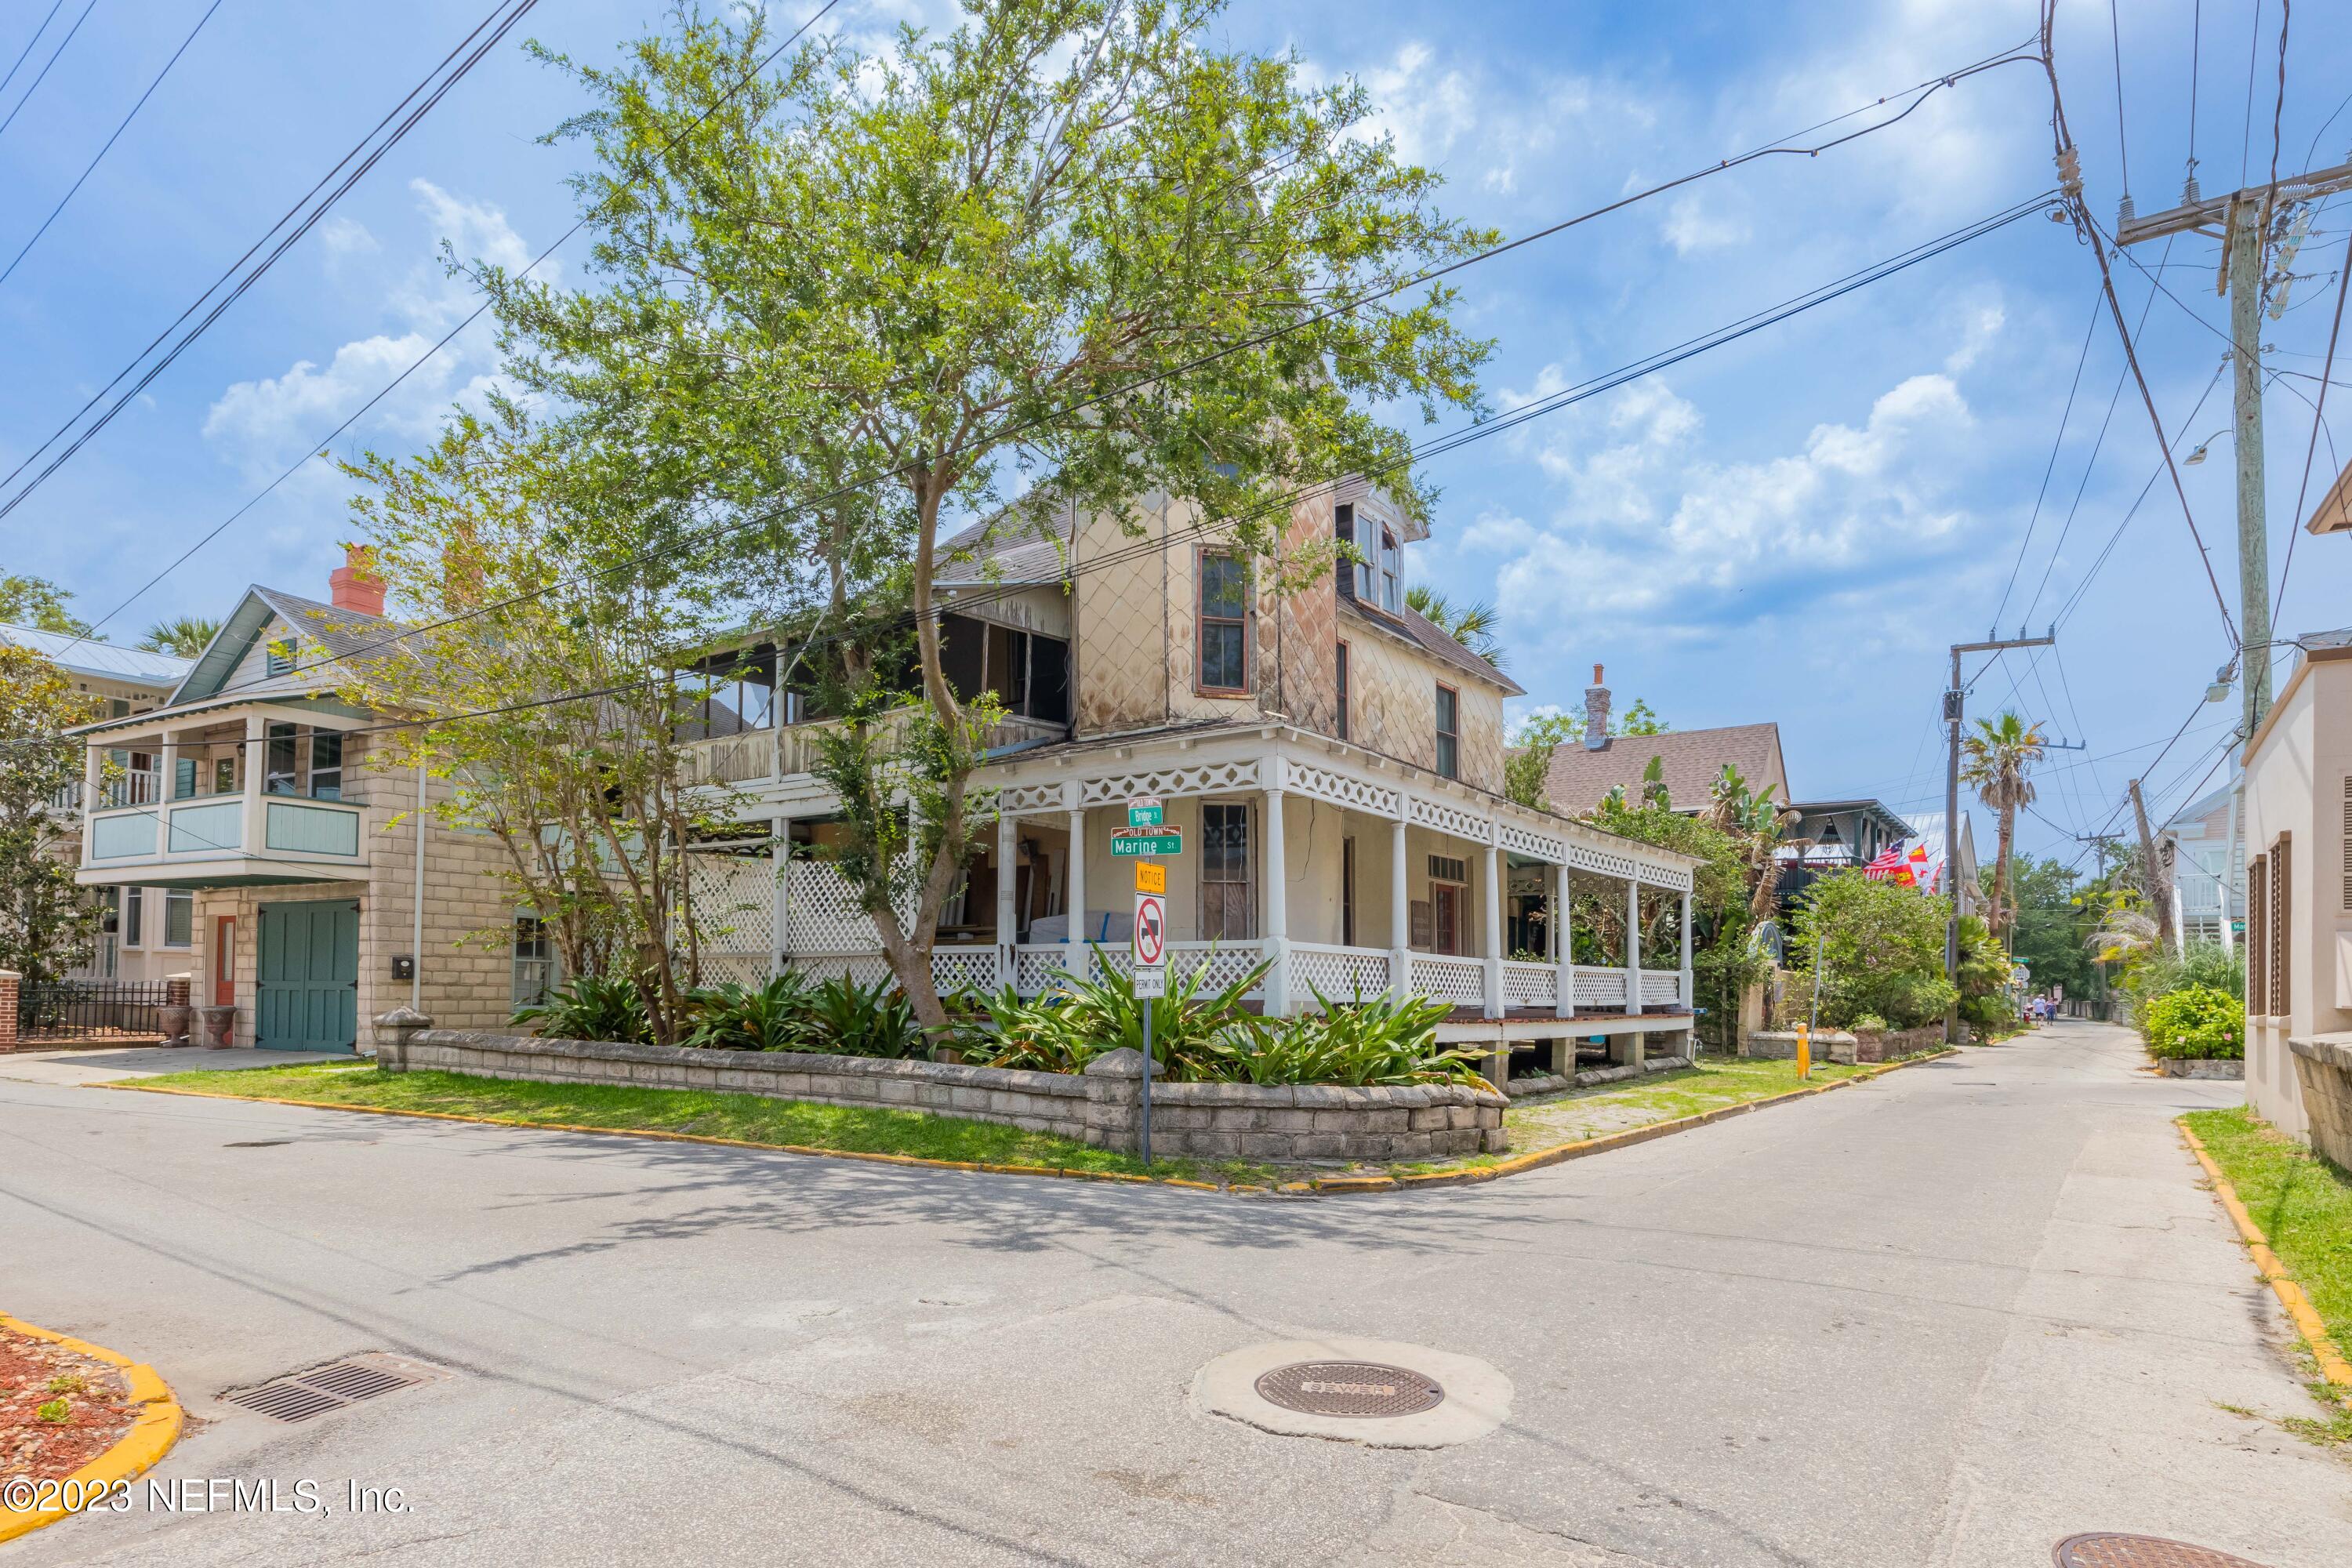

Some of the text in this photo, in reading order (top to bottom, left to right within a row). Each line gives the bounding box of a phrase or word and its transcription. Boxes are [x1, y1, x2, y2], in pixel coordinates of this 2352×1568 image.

[1135, 810, 1152, 822] Bridge
[1145, 826, 1163, 836] TOWN
[1116, 839, 1157, 854] Marine
[1140, 869, 1161, 886] NOTICE
[1137, 979, 1163, 989] PERMIT ONLY
[1311, 1384, 1385, 1394] SEWER
